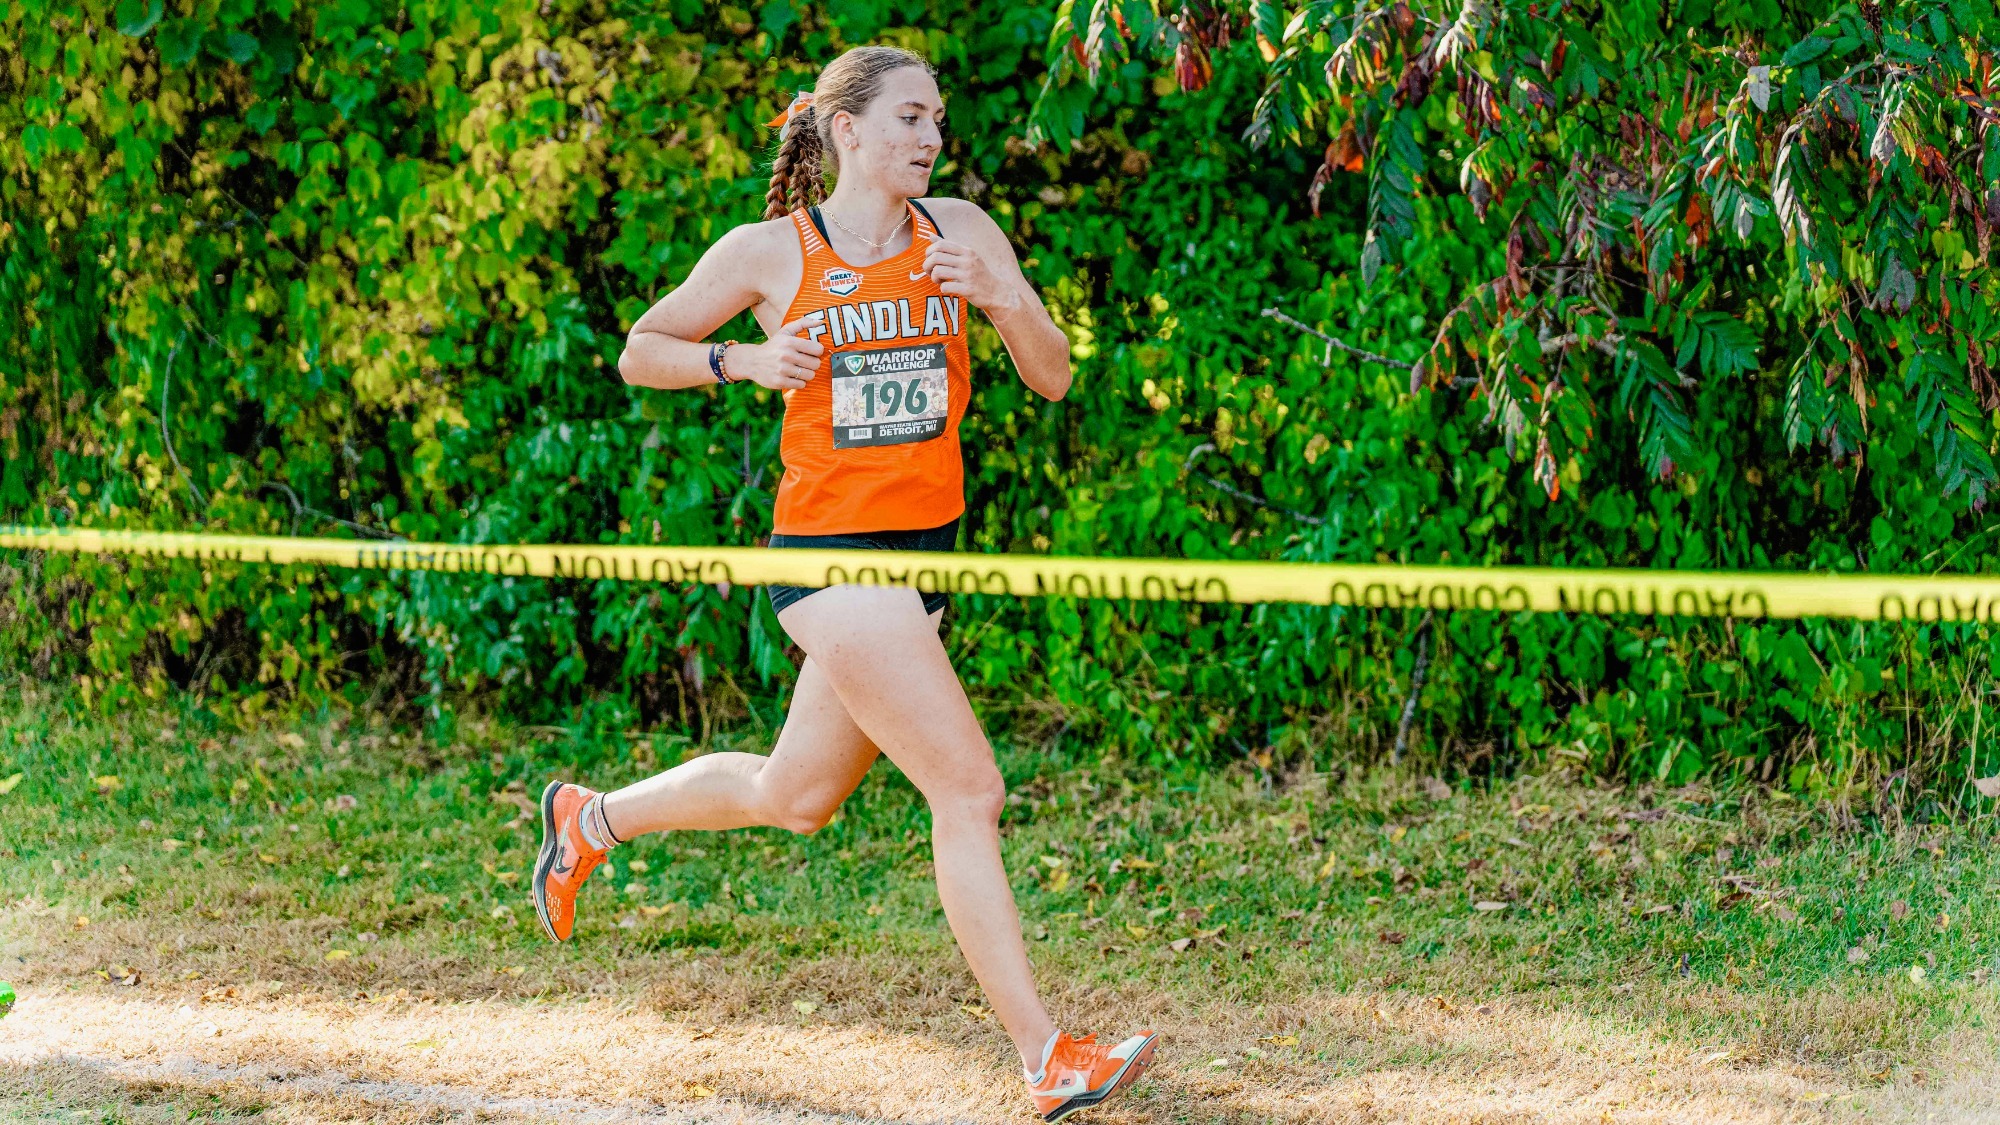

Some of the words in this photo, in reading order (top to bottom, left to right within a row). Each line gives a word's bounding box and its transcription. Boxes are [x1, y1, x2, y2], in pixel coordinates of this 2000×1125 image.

[821, 274, 862, 290] MIDWEST
[830, 273, 852, 281] GREAT
[804, 296, 959, 348] FINDLAY
[865, 348, 936, 366] WARRIOR
[871, 360, 930, 373] CHALLENGE
[861, 378, 928, 419] 196
[879, 425, 924, 437] DETROIT,
[925, 424, 937, 432] MI
